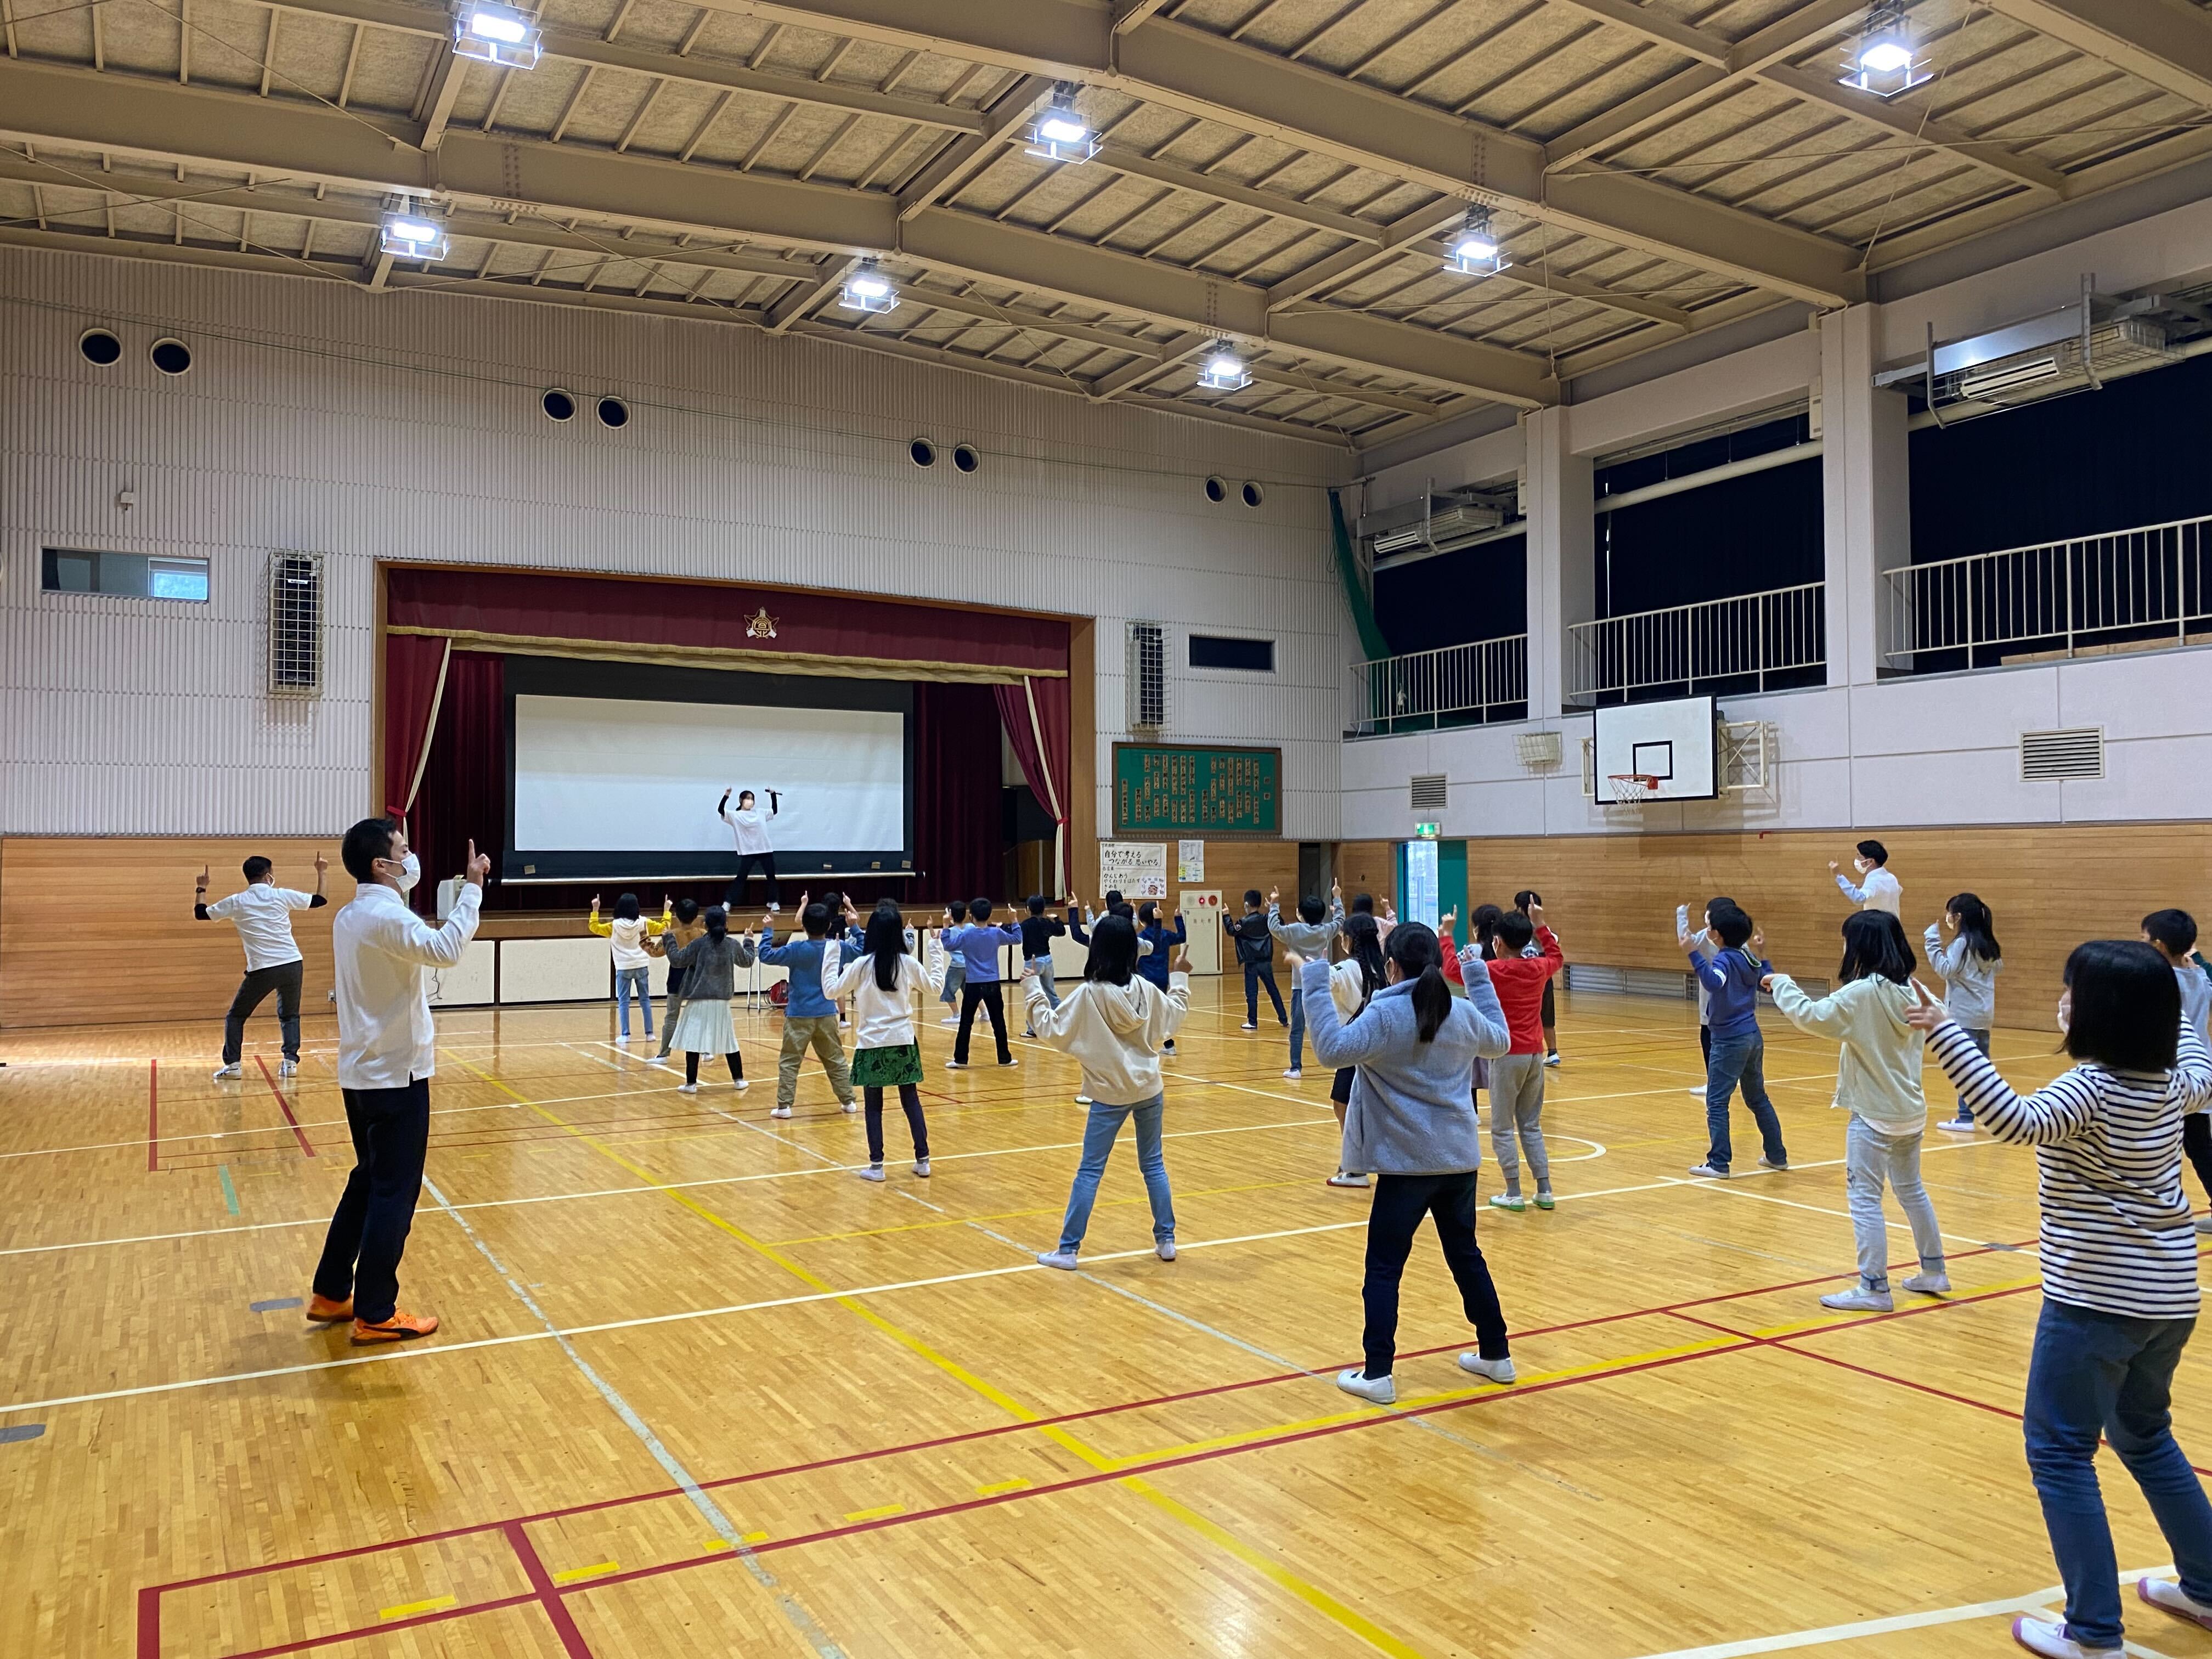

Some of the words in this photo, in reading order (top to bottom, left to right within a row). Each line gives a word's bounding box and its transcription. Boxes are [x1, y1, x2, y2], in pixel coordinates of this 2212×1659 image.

[1104, 850, 1142, 859] 自分で考える
